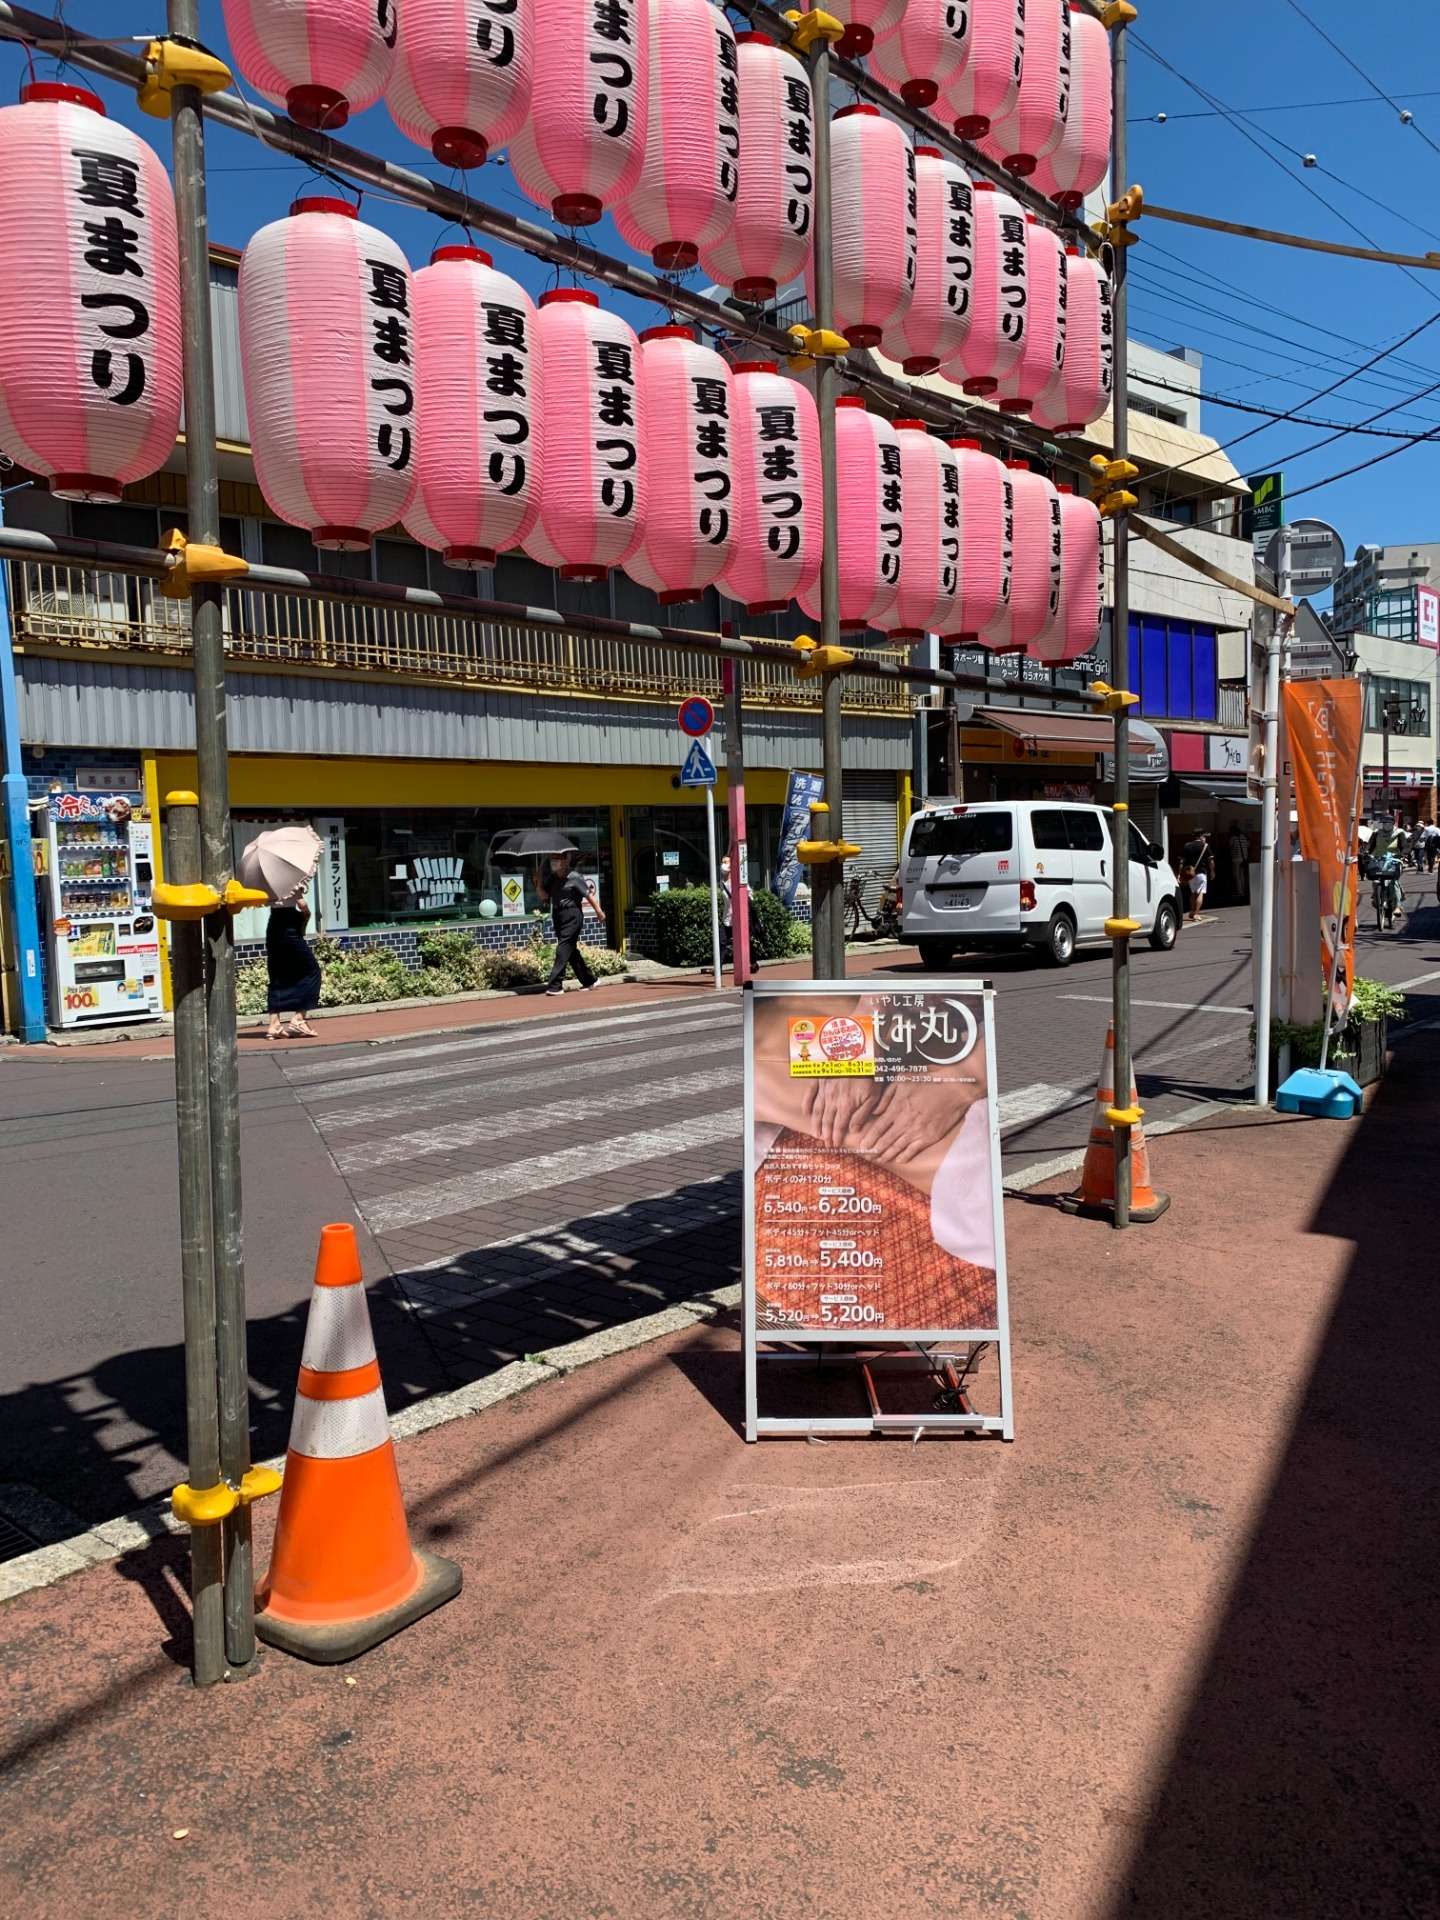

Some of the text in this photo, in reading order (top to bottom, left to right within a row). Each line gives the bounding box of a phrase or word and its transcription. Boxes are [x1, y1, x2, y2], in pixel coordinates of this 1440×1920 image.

[784, 75, 812, 236] 夏まつり
[71, 149, 150, 405] 夏まつり
[947, 181, 973, 315] 夏まつり
[999, 215, 1026, 341] 夏まつり
[366, 258, 413, 470] 夏まつり
[481, 302, 529, 495] 夏まつり
[592, 340, 637, 517] 夏まつり
[692, 377, 731, 545] 夏まつり
[756, 405, 803, 559] 夏まつり
[879, 444, 902, 584] 夏まつり
[1252, 505, 1275, 515] SMBC
[1095, 660, 1108, 676] girl
[765, 1174, 832, 1183] ボディのみ120分
[818, 1196, 882, 1215] 6,200円
[820, 1250, 883, 1269] 5,400円
[821, 1305, 885, 1323] 5,200円
